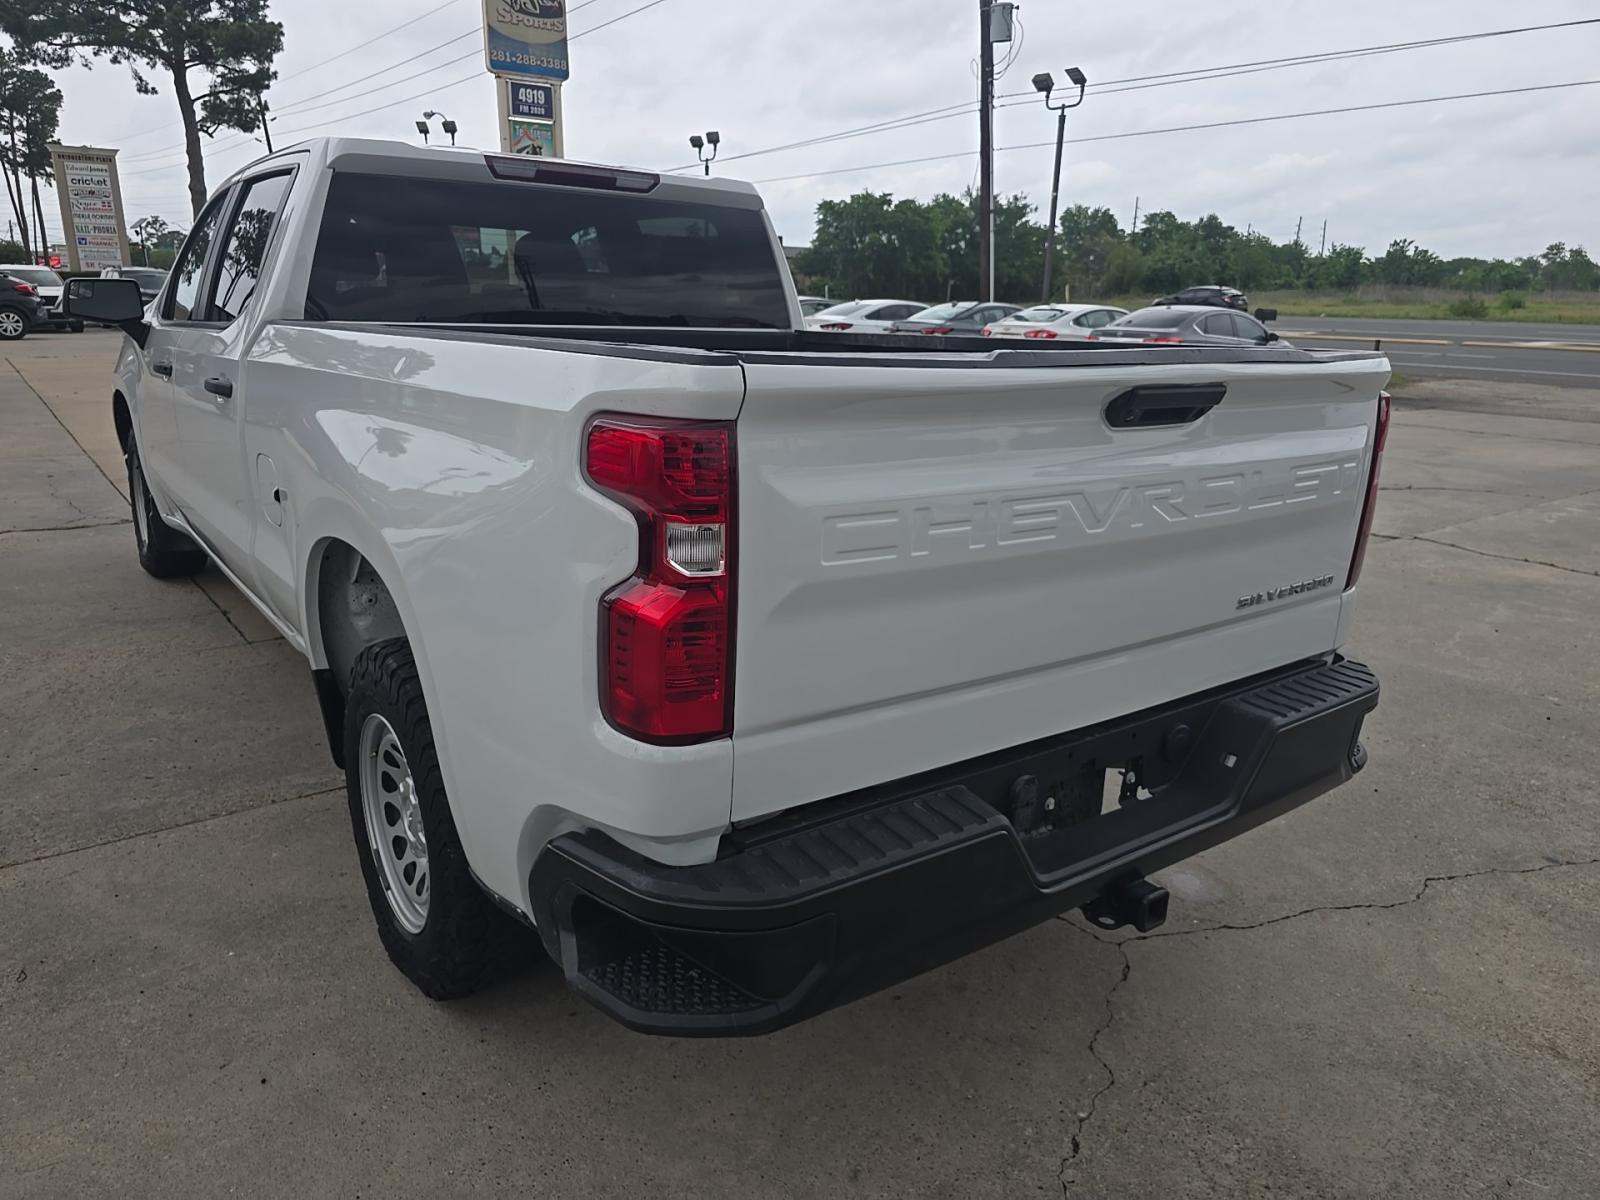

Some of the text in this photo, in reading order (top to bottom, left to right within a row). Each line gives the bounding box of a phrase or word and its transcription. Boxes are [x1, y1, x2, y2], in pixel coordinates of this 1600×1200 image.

[496, 7, 565, 32] SPORTS
[518, 87, 545, 105] 4919
[71, 177, 108, 187] cricket
[821, 461, 1358, 567] CHEVROLET
[1235, 574, 1334, 610] SILVERADO
